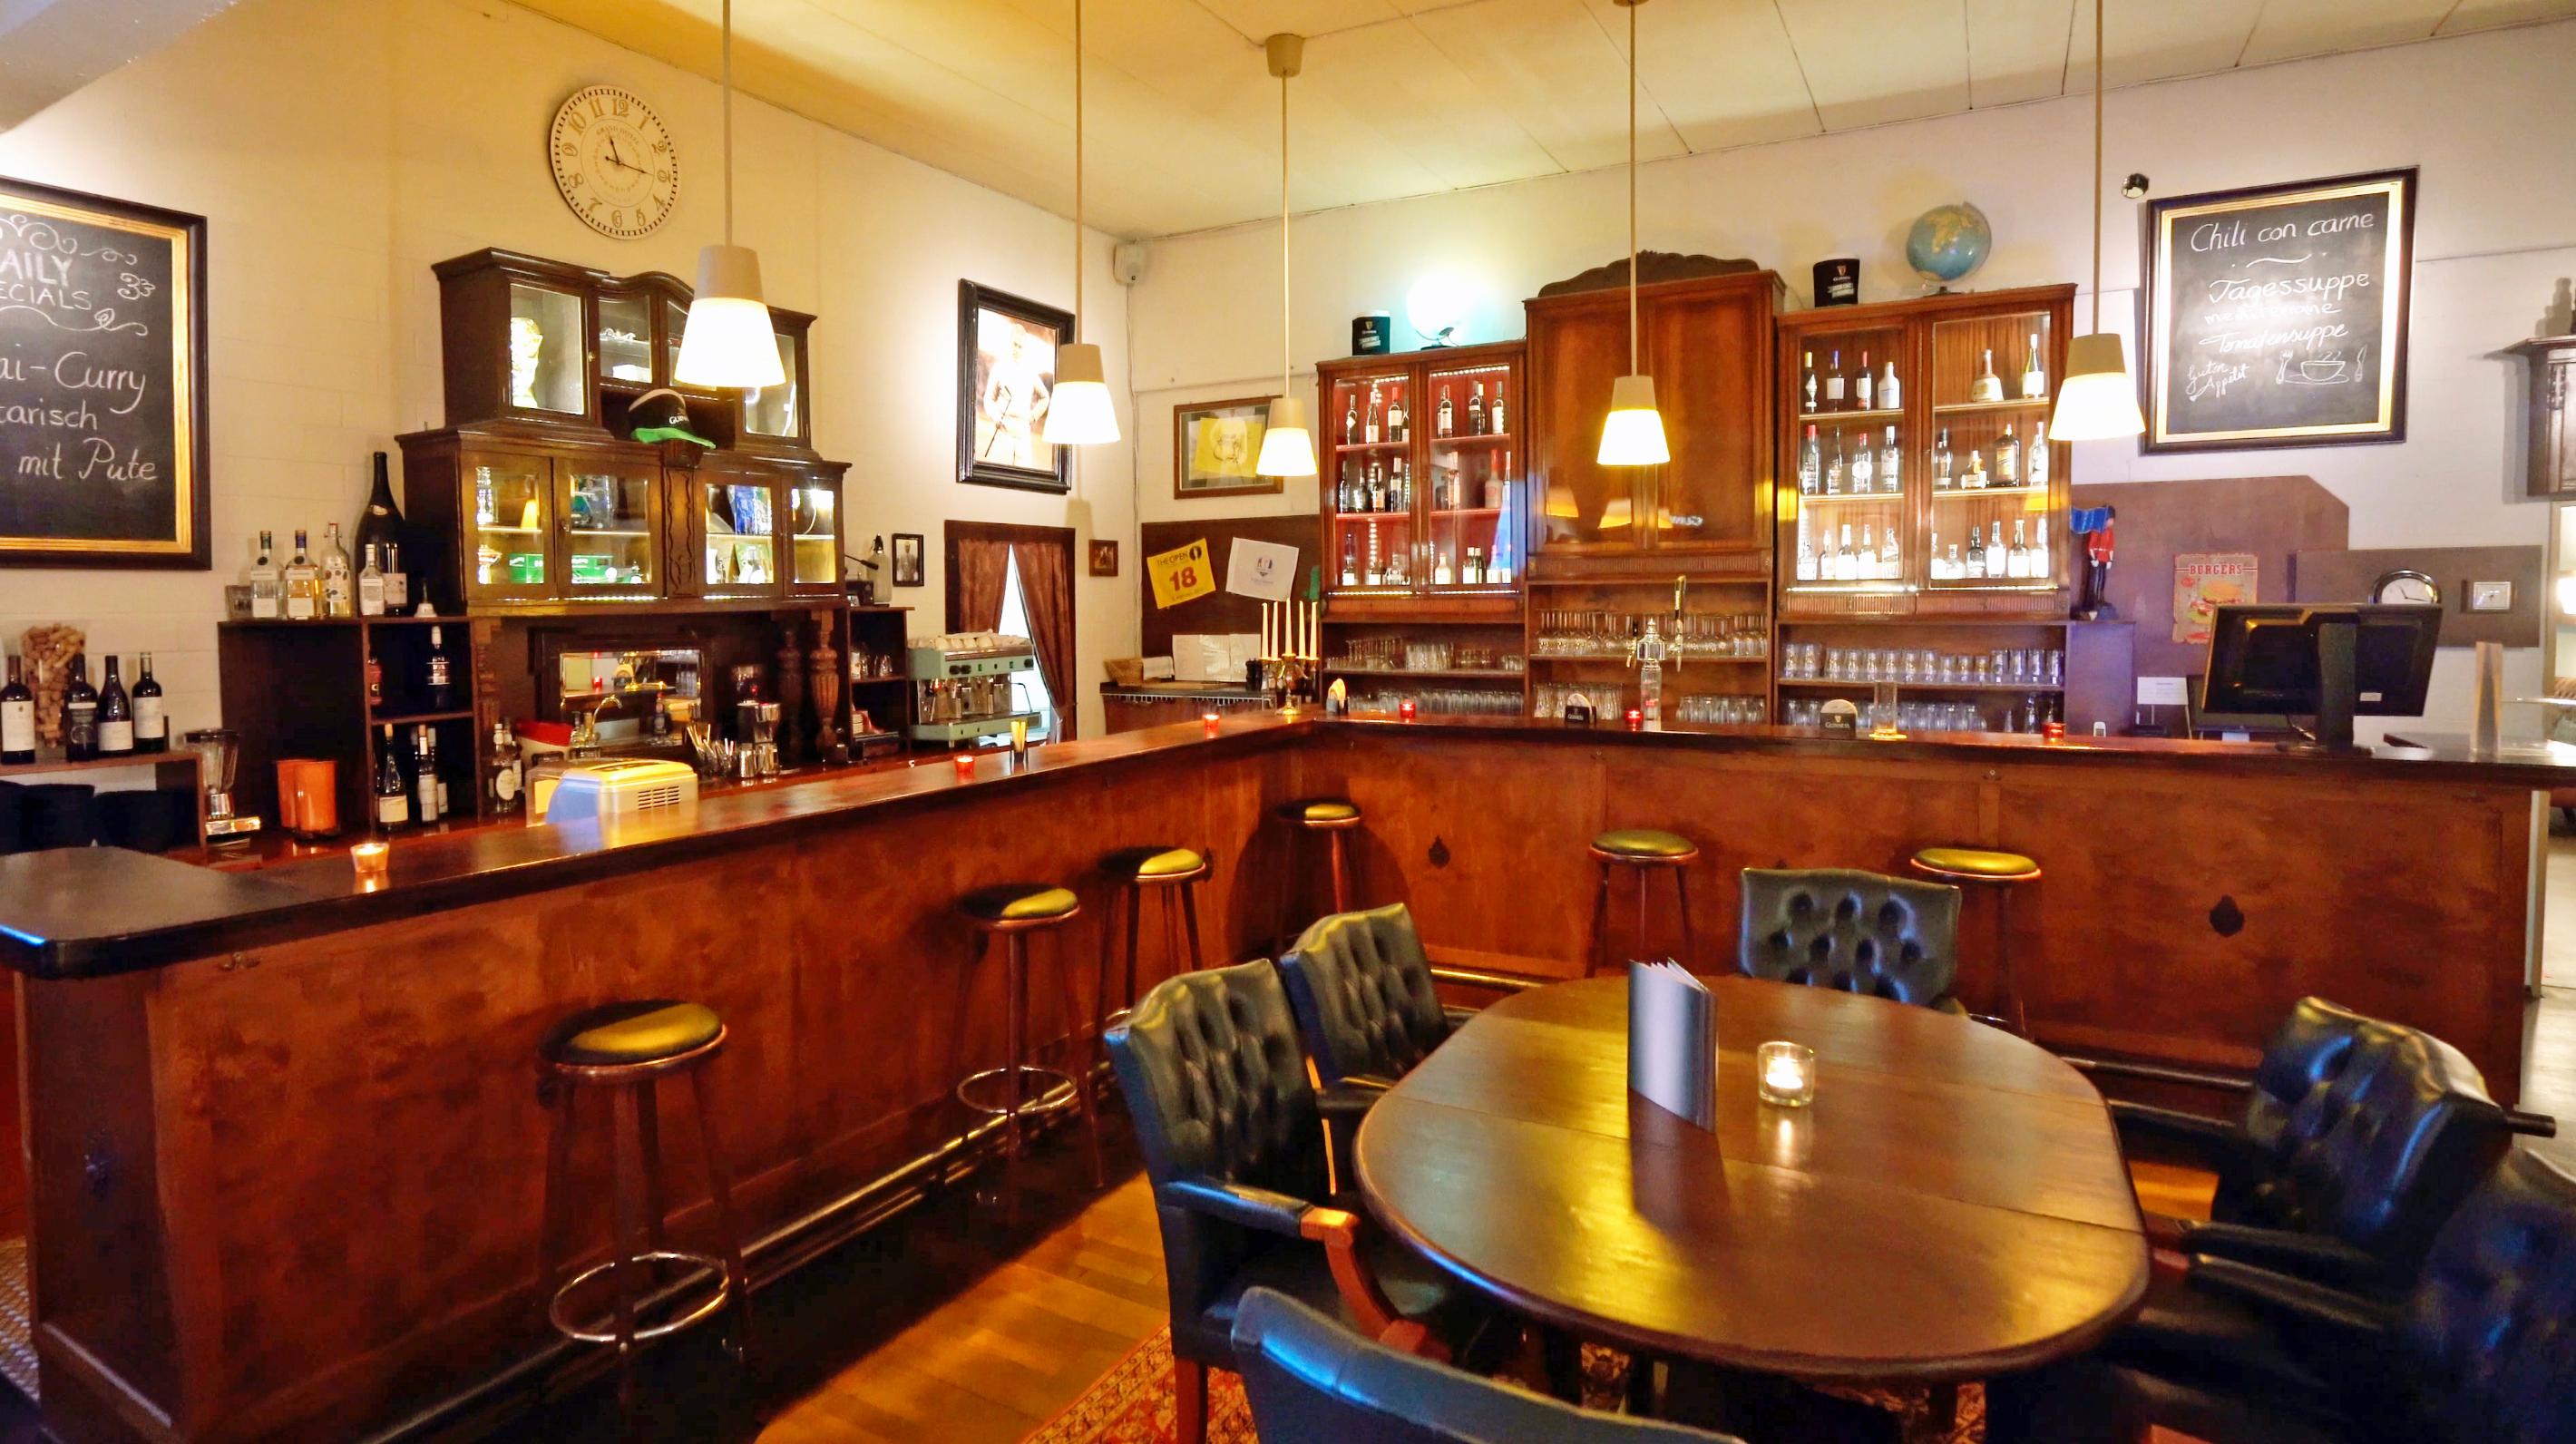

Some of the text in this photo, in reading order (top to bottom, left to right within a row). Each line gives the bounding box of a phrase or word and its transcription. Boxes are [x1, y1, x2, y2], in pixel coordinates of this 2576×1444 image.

[589, 97, 605, 118] 11
[611, 98, 629, 118] 12
[568, 111, 587, 136] 10
[639, 115, 649, 131] 1
[561, 141, 579, 157] 9
[651, 140, 668, 156] 2
[567, 172, 584, 189] 8
[656, 170, 671, 184] 3
[589, 197, 603, 213] 7
[652, 193, 666, 211] 4
[610, 210, 623, 228] 6
[635, 208, 647, 227] 5
[2191, 213, 2375, 252] Chili con carne
[2209, 272, 2370, 307] Tagessuppe
[18, 437, 159, 482] mit Pute
[1168, 551, 1189, 564] OPEN
[1169, 566, 1197, 591] 18
[2190, 564, 2243, 575] BURGERS
